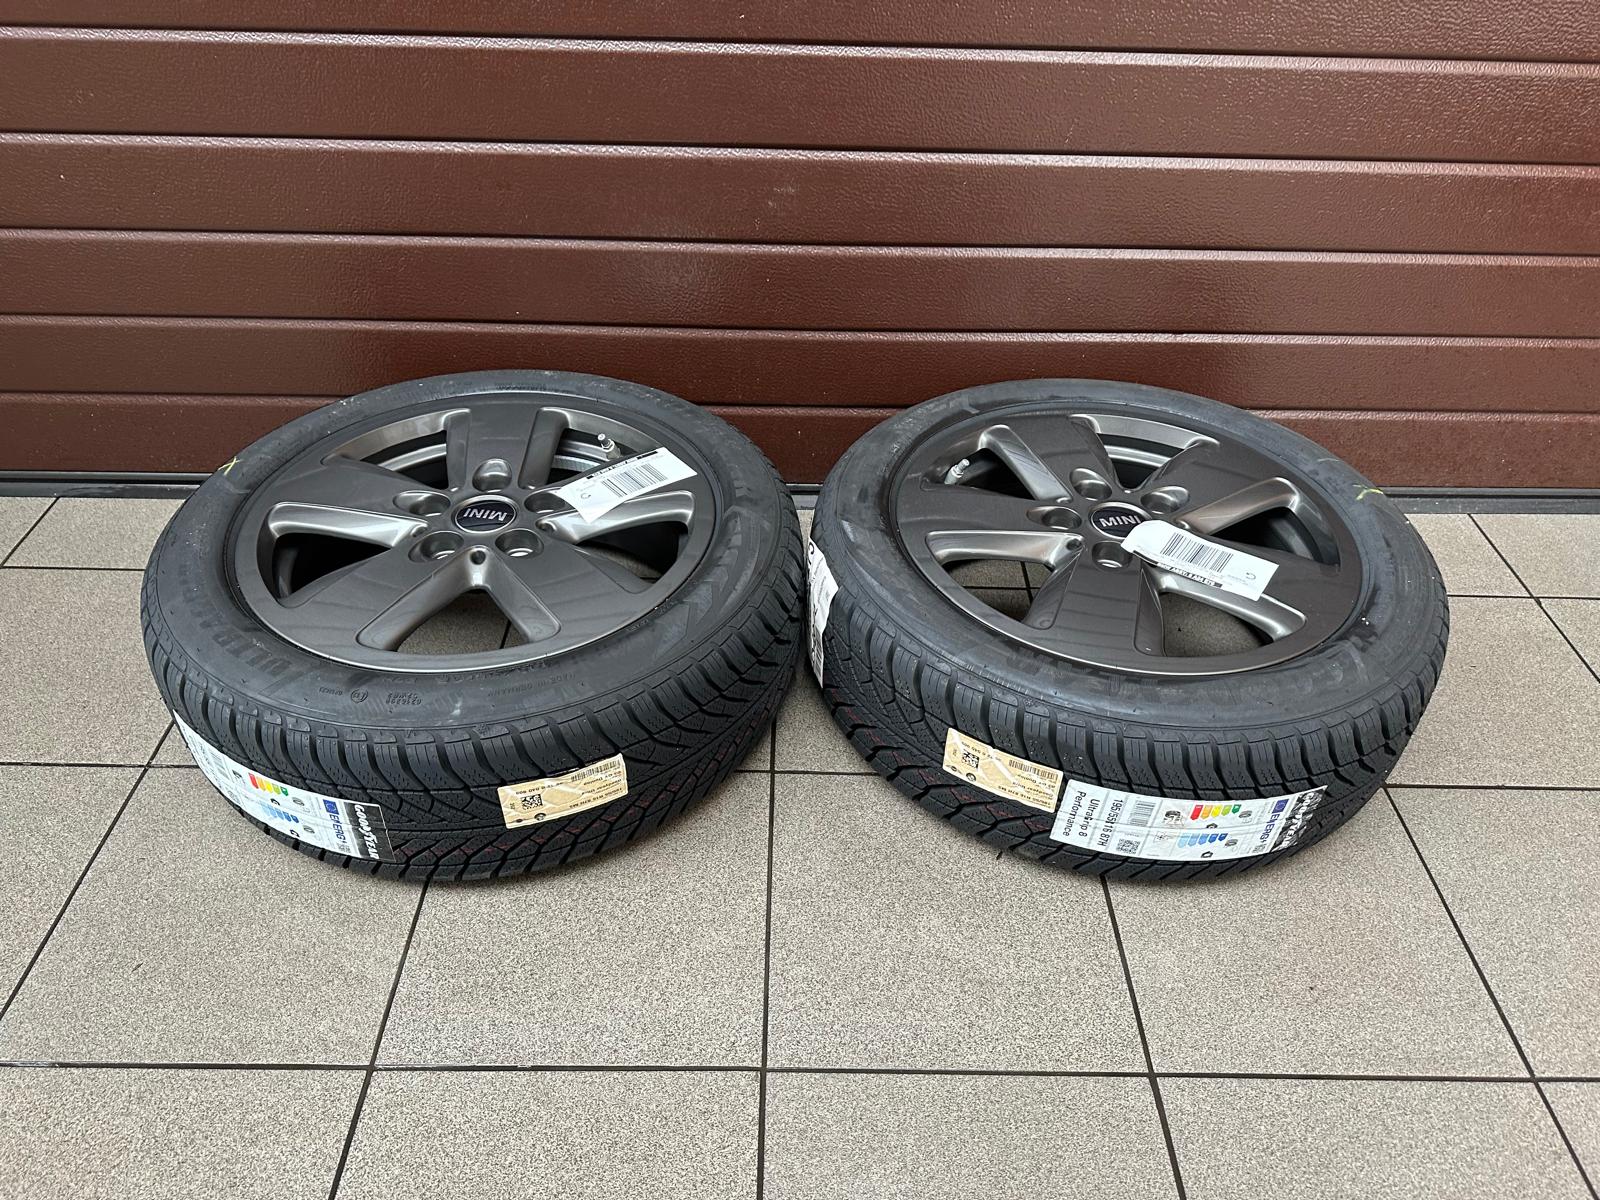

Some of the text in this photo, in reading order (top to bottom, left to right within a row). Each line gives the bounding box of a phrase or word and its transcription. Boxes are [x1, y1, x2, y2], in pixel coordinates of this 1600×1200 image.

[463, 508, 508, 522] MINI
[1099, 516, 1141, 527] MINI
[1062, 790, 1087, 837] Performance
[354, 804, 380, 860] GOODYEAR
[1097, 832, 1109, 846] 87H
